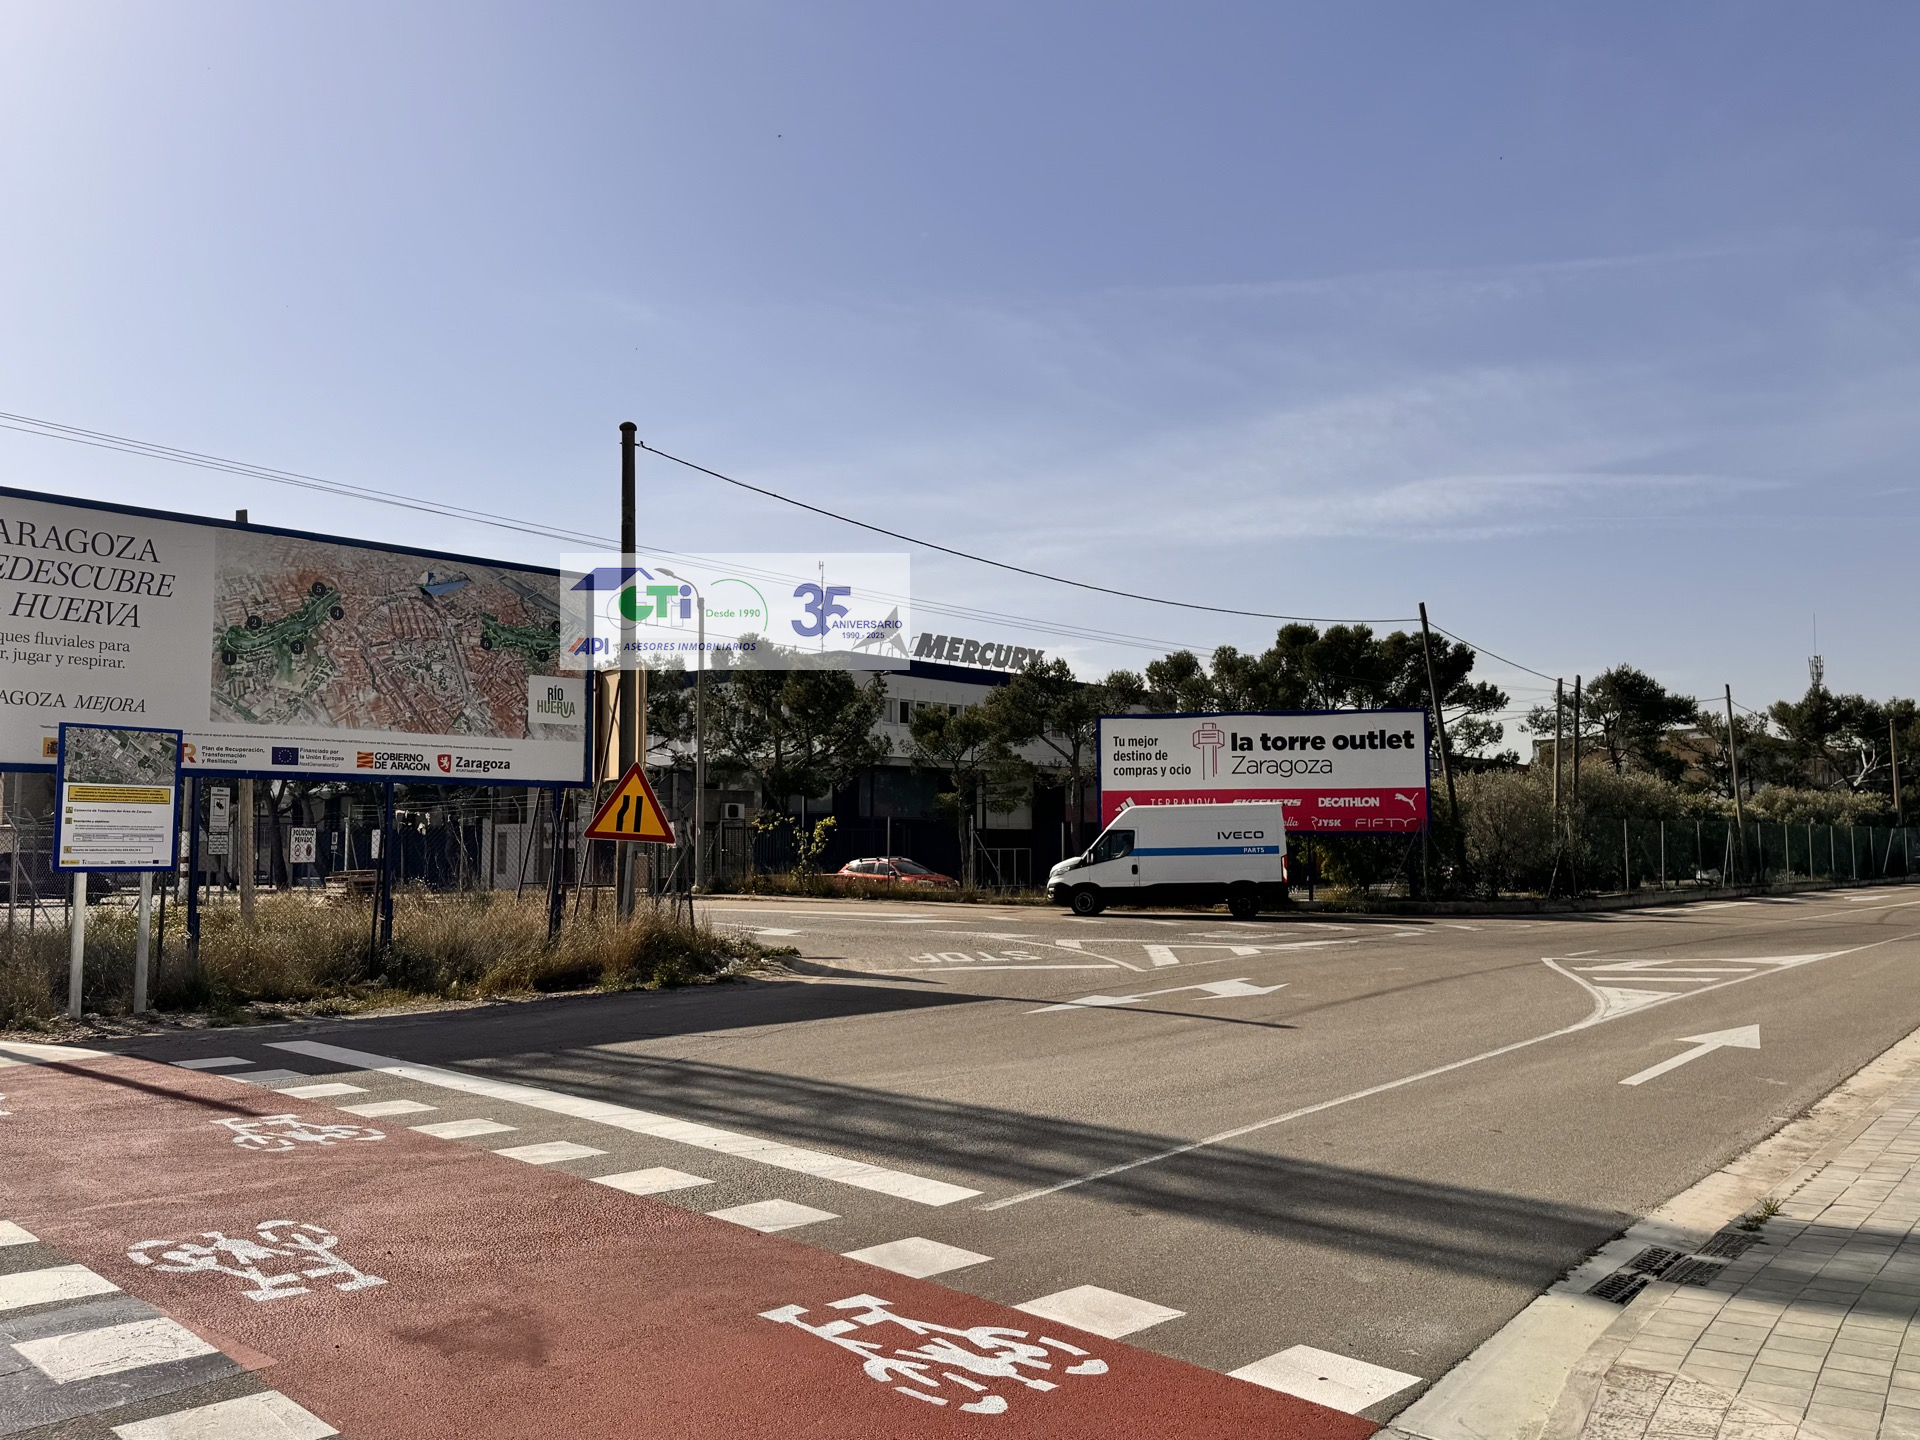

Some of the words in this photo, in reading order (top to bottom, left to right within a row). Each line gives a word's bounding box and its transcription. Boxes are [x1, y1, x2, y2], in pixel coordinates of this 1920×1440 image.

[9, 592, 140, 628] HUERVA
[34, 631, 95, 649] fluviales
[99, 640, 130, 653] para
[12, 648, 52, 665] jugar
[55, 654, 64, 667] y
[68, 655, 126, 670] respirar.
[913, 632, 1045, 670] MERCURY
[547, 685, 564, 702] RÍO
[73, 695, 146, 713] MEJORA
[537, 700, 575, 718] HUERVA
[1113, 736, 1125, 747] Tu
[1128, 735, 1158, 748] mejor
[1230, 732, 1254, 751] la
[1259, 732, 1326, 751] torre
[1332, 729, 1415, 750] outlet
[374, 752, 424, 762] GOBIERNO
[1113, 750, 1152, 761] destino
[1155, 750, 1168, 761] de
[374, 761, 387, 770] DE
[455, 756, 511, 772] Zaragoza
[1113, 766, 1158, 777] compras
[1160, 766, 1167, 777] y
[1169, 763, 1191, 775] ocio
[1231, 755, 1333, 778] Zaragoza
[1318, 797, 1380, 807] DECATHLON
[1317, 819, 1341, 827] JYSK
[1355, 818, 1416, 828] FIFTY
[1217, 830, 1264, 840] IVECO
